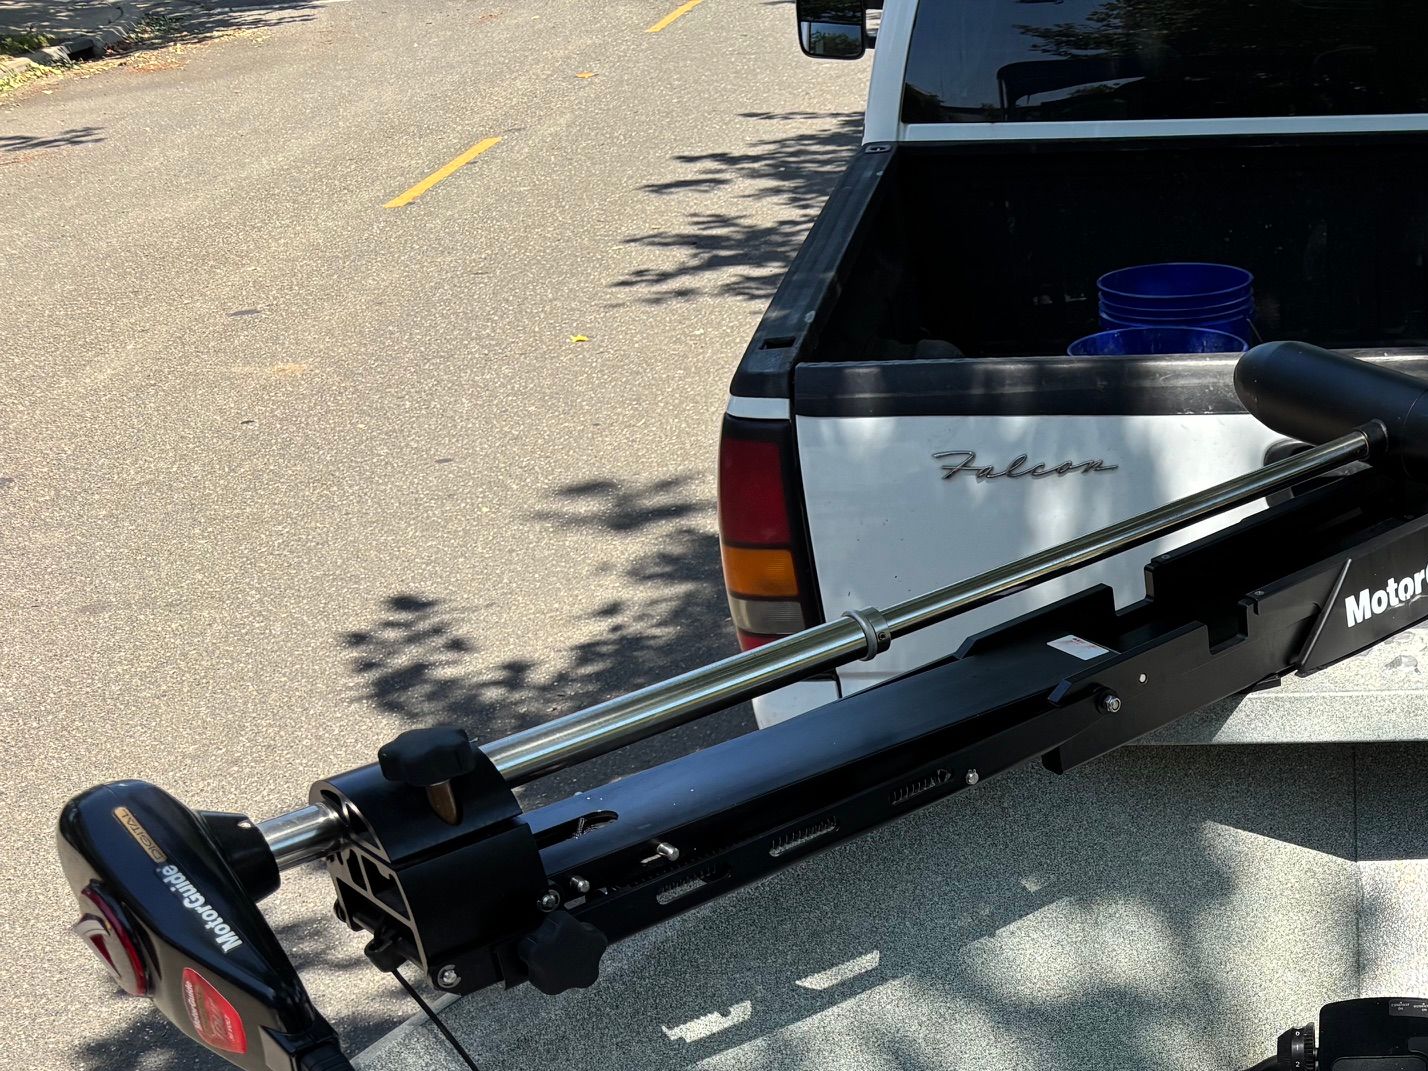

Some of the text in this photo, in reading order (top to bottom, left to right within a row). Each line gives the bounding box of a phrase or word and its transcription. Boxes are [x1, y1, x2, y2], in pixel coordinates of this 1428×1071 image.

[932, 450, 1119, 480] Falcon
[121, 808, 166, 860] DIGITAL
[161, 864, 243, 954] MotorGuide
[184, 980, 204, 1034] MotorGuide
